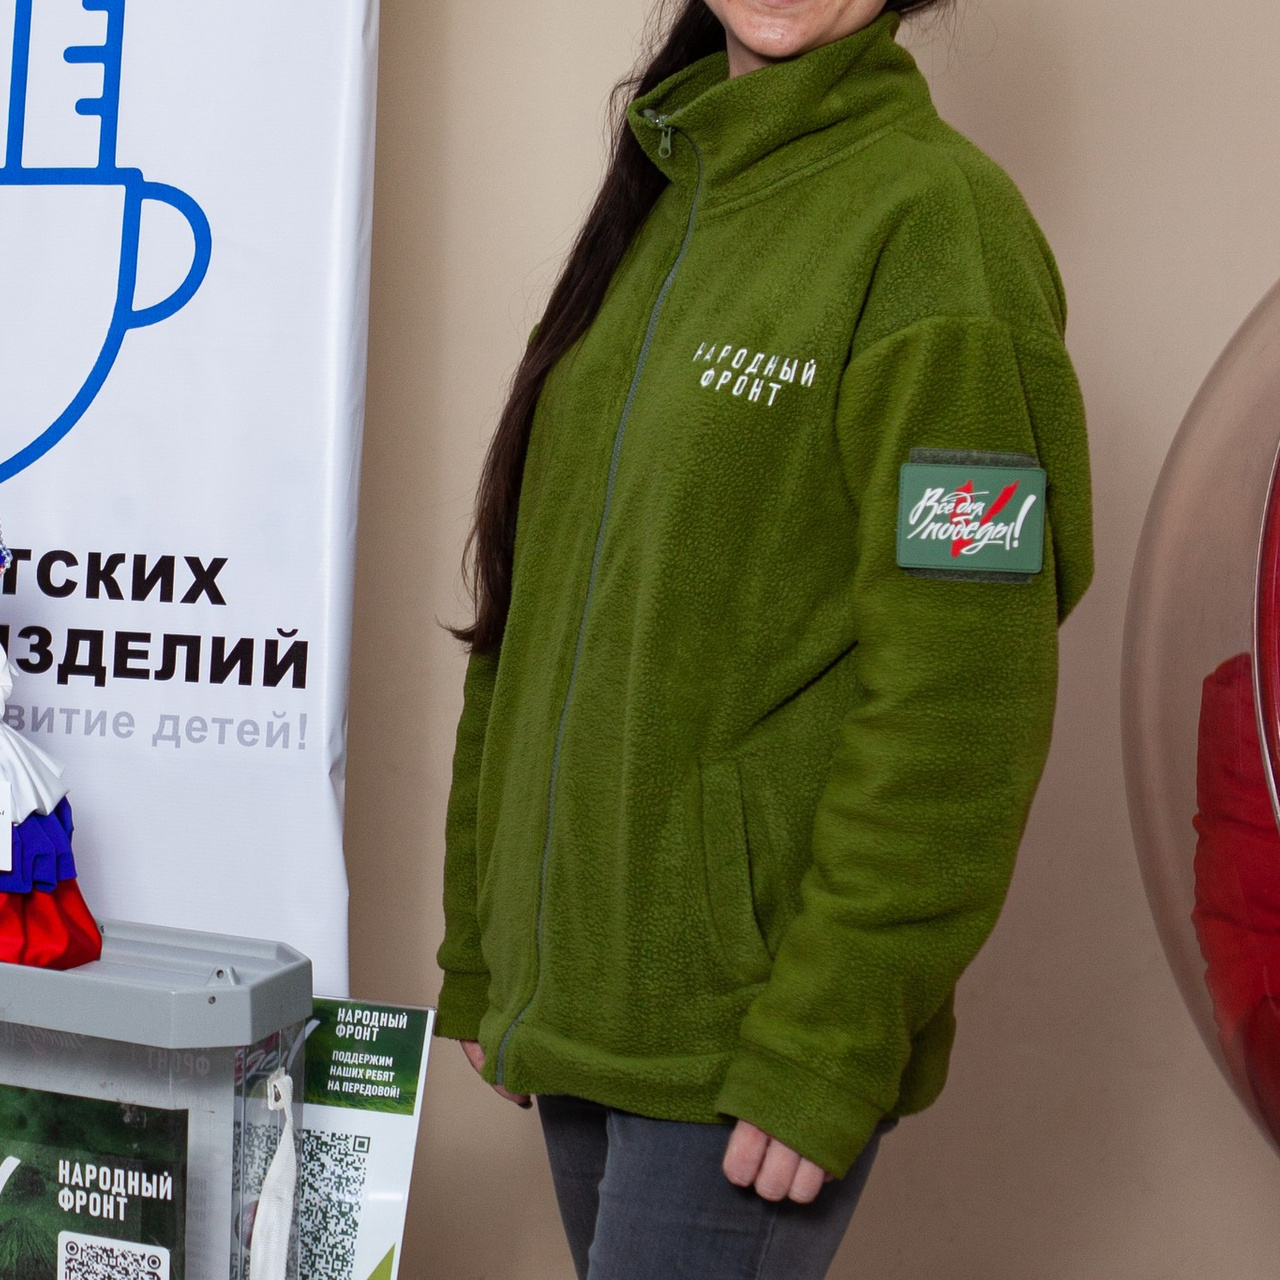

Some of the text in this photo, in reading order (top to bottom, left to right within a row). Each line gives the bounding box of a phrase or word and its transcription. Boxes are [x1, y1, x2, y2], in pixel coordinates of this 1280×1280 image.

[692, 341, 817, 388] НАРОДНЫЙ
[700, 367, 782, 406] ФРОНТ
[940, 490, 990, 519] для
[2, 704, 136, 739] витие
[151, 710, 309, 751] детей!
[335, 1023, 379, 1042] ФРОНТ
[337, 1007, 408, 1029] НАРОДНЫЙ
[332, 1050, 394, 1067] ПОДДЕРЖИМ
[329, 1064, 395, 1083] НАШИХ РЕБЯТ
[327, 1080, 400, 1099] НА ПЕРЕДОВОЙ!
[58, 1160, 173, 1201] НАРОДНЫЙ
[58, 1187, 128, 1221] ФРОНТ
